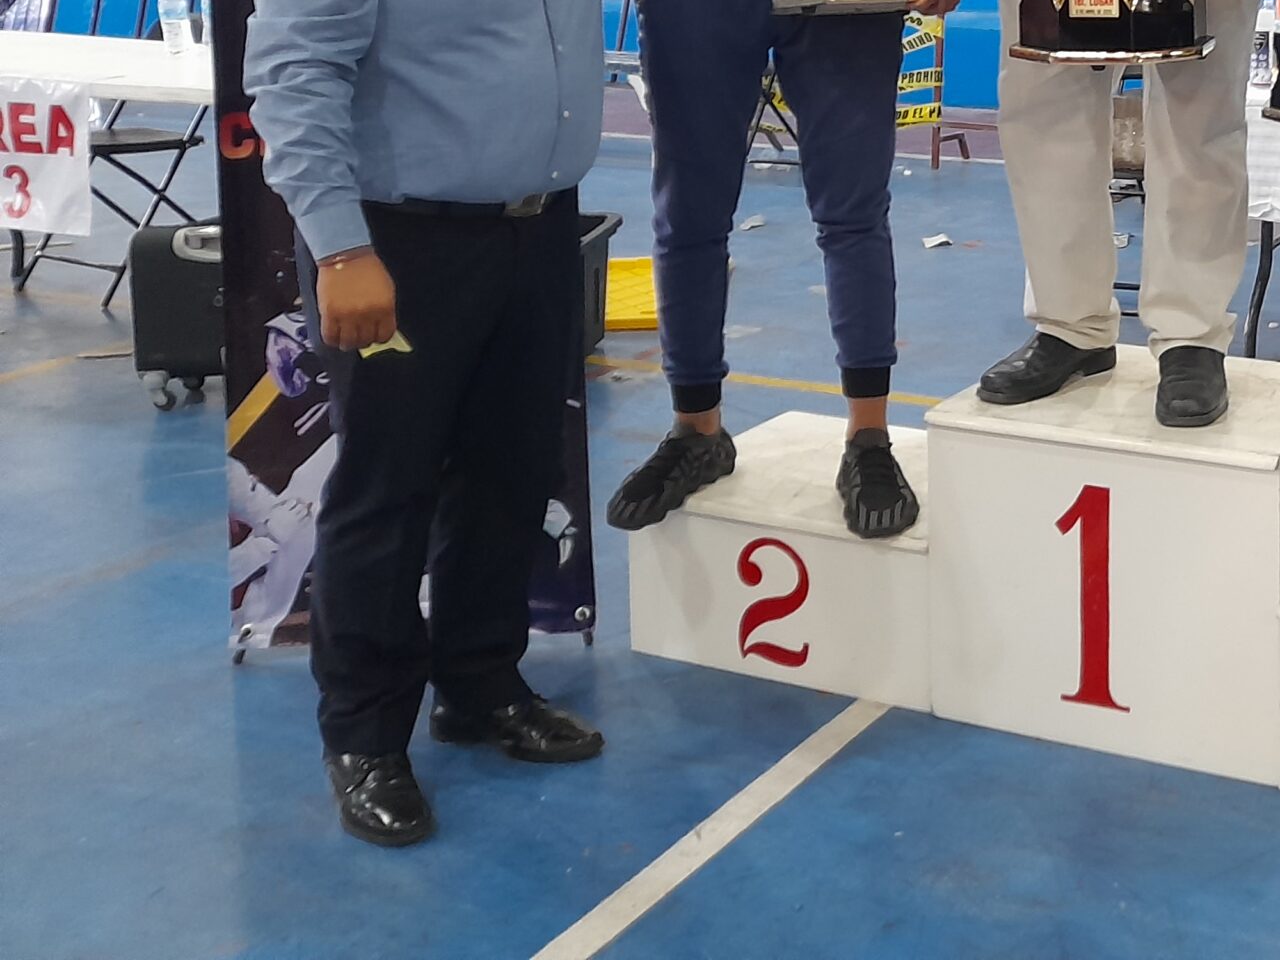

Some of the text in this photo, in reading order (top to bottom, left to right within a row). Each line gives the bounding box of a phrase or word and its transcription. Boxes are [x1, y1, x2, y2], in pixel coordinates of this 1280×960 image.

[3, 164, 32, 219] 3
[737, 536, 810, 668] 2
[1055, 484, 1131, 714] 1
